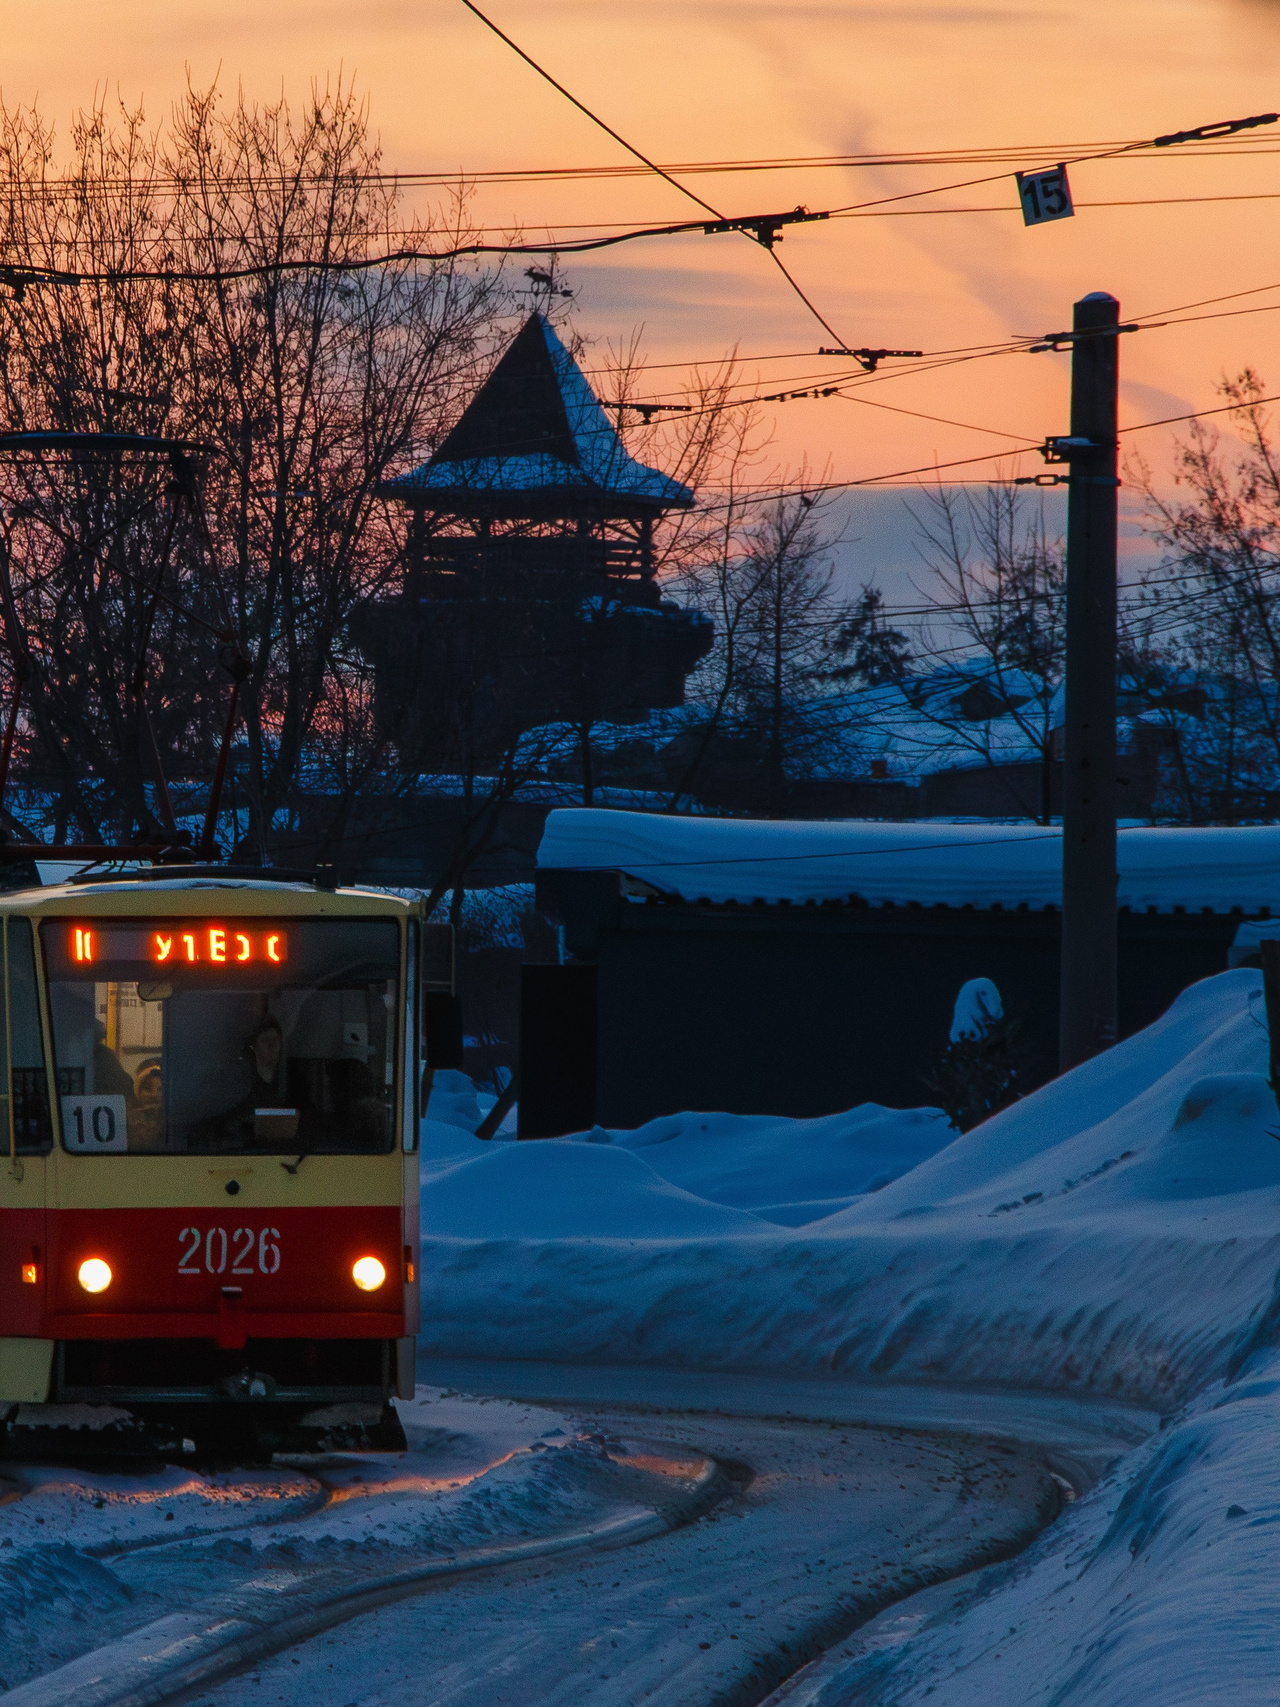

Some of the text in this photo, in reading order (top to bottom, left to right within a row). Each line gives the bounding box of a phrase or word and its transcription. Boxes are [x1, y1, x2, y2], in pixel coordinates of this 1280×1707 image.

[1023, 174, 1068, 218] 15
[73, 1106, 116, 1144] 10
[178, 1227, 281, 1275] 2026
